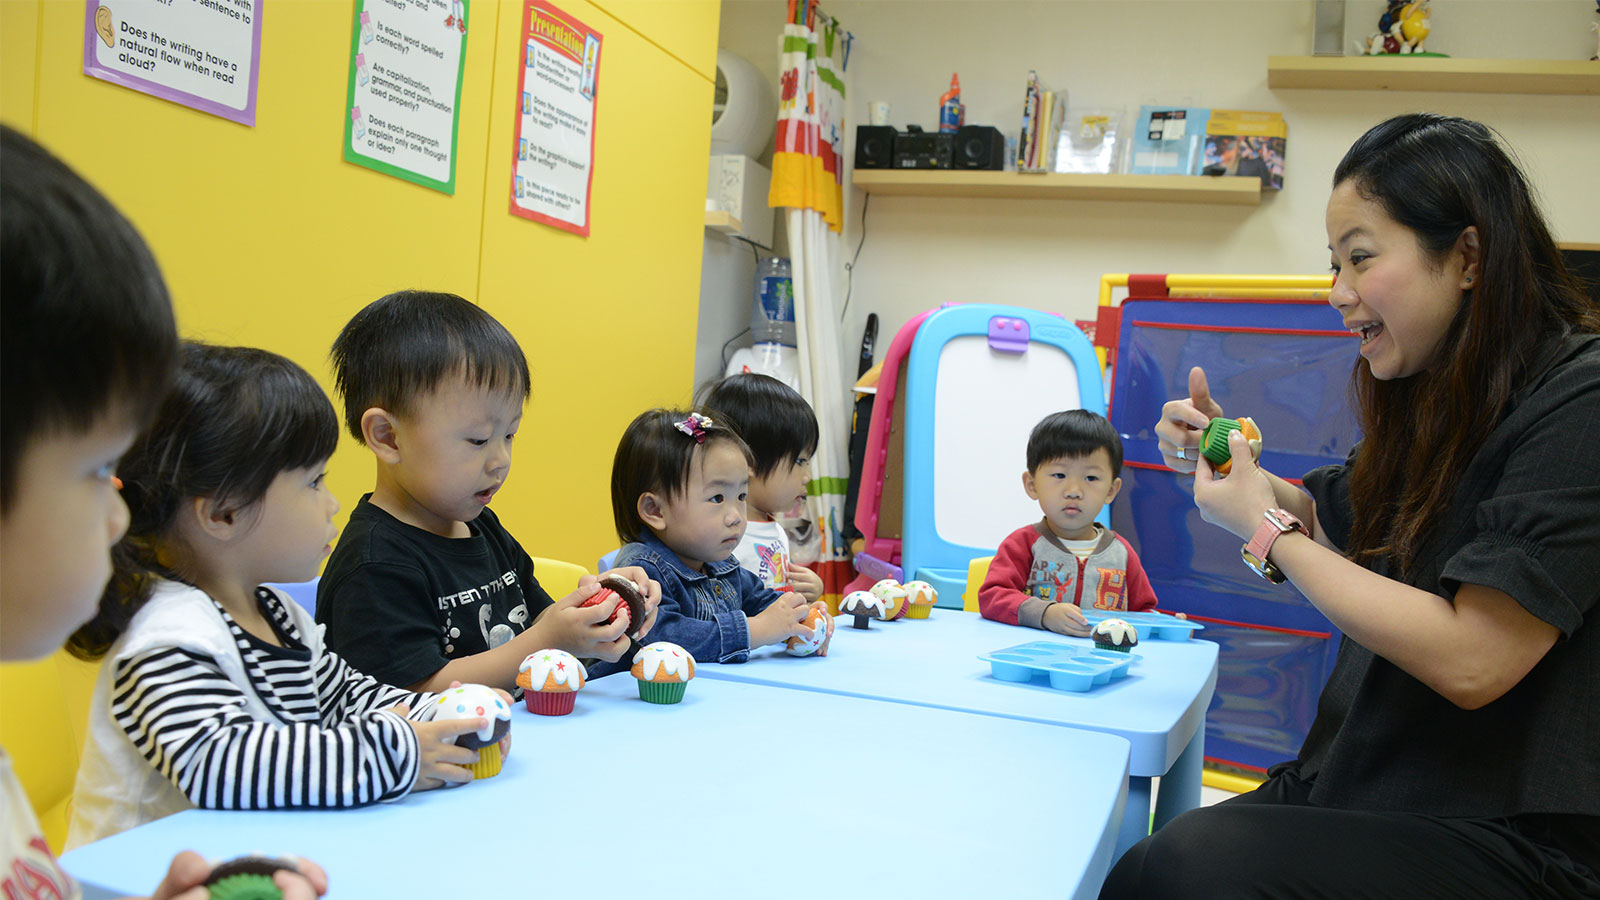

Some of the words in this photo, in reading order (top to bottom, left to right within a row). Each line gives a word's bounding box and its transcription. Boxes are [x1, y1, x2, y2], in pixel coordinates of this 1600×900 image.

[199, 0, 240, 20] sentence
[242, 13, 251, 24] to
[234, 0, 252, 11] with
[415, 1, 429, 11] and
[120, 21, 148, 41] Does
[150, 31, 167, 46] the
[170, 40, 203, 62] writing
[205, 52, 229, 69] have
[231, 63, 238, 71] a
[375, 34, 410, 55] correctly?
[377, 21, 383, 31] Is
[385, 26, 402, 40] each
[403, 34, 420, 48] word
[420, 43, 444, 59] spelled
[530, 10, 585, 58] Presentation
[118, 52, 156, 72] aloud?
[119, 38, 158, 58] natural
[160, 50, 181, 66] flow
[184, 60, 210, 76] when
[212, 70, 235, 84] read
[372, 62, 384, 74] Are
[386, 69, 432, 96] capitalization,
[370, 86, 387, 100] used
[388, 92, 420, 112] properly?
[371, 74, 402, 96] grammar,
[403, 88, 416, 99] and
[416, 93, 452, 114] punctuation
[368, 114, 386, 129] Does
[387, 122, 404, 136] each
[405, 129, 439, 148] paragraph
[367, 139, 376, 148] or
[376, 140, 395, 155] idea?
[368, 128, 394, 144] explain
[394, 136, 409, 150] only
[410, 142, 422, 153] one
[423, 146, 448, 163] thought
[530, 142, 537, 152] Do
[1031, 570, 1072, 583] ELINGS
[1032, 560, 1064, 572] APPY
[437, 588, 482, 610] ISTEN
[1092, 567, 1127, 611] H
